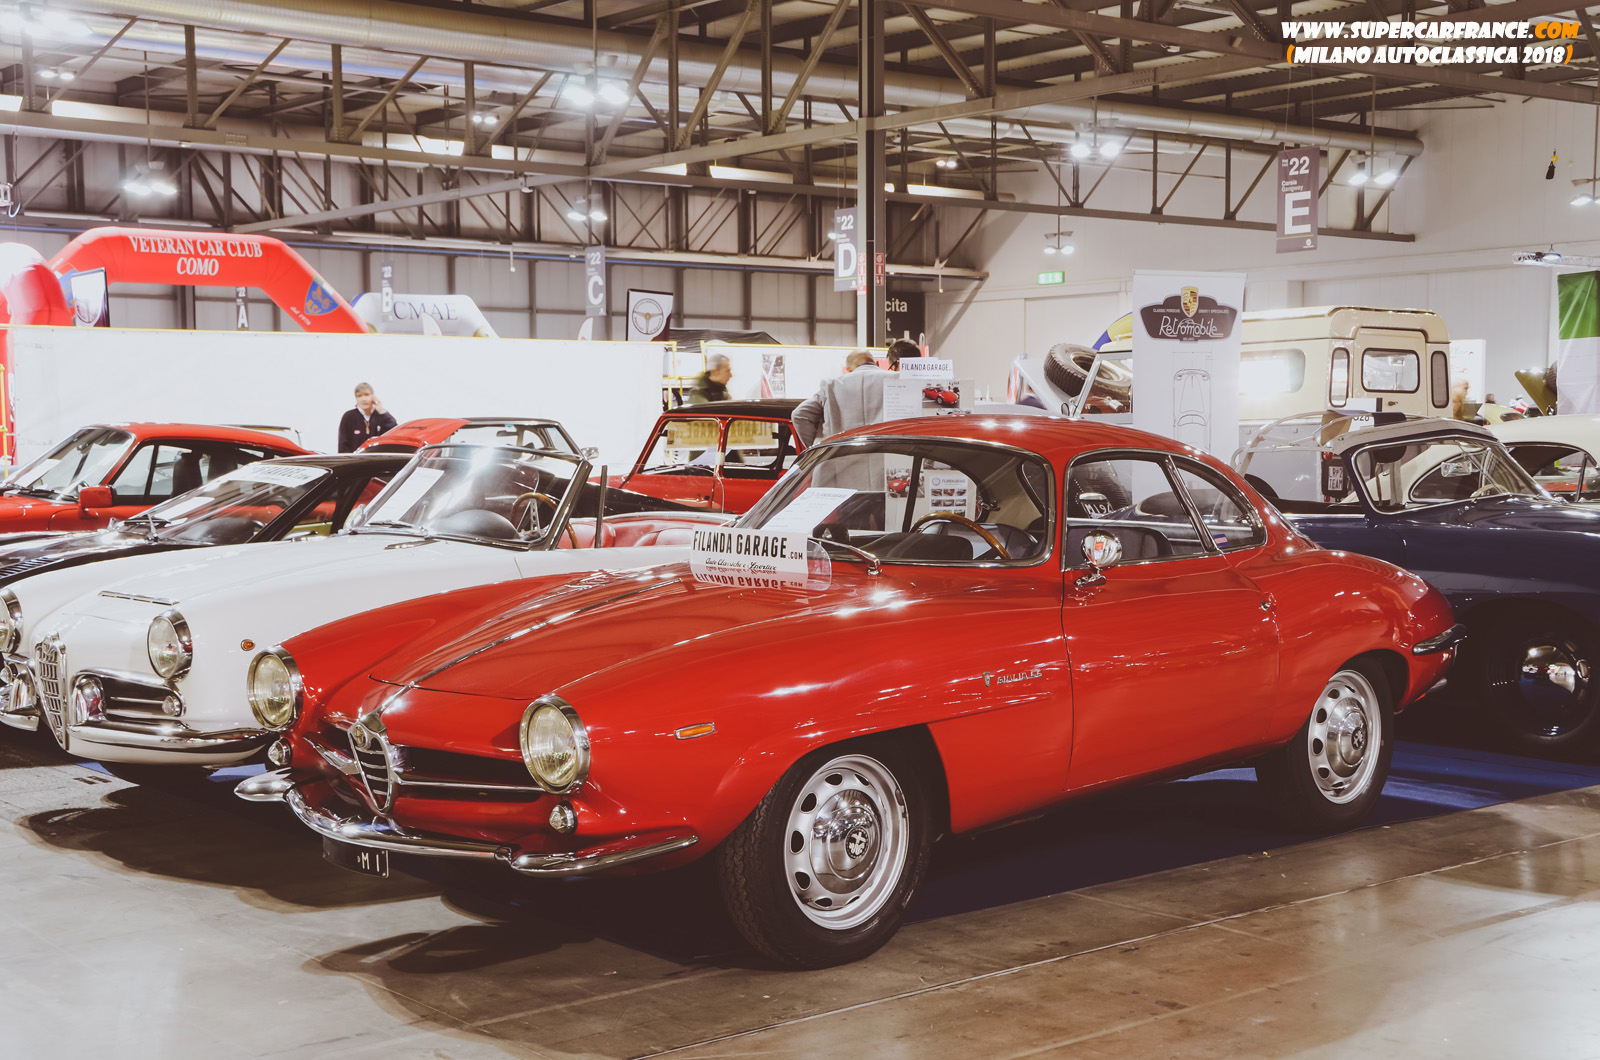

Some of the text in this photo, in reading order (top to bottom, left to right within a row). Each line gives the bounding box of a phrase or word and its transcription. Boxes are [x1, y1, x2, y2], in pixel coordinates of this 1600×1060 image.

[1289, 156, 1310, 176] 22
[1281, 179, 1297, 187] Corsia
[841, 215, 854, 230] 22
[1284, 190, 1311, 235] E
[128, 235, 263, 258] VETERAN CAR CLUB
[176, 257, 219, 276] COMO
[590, 252, 601, 265] 22
[838, 242, 857, 277] D
[382, 287, 393, 312] B
[588, 275, 604, 305] C
[237, 305, 248, 328] A
[393, 301, 458, 320] CMAE
[1158, 315, 1224, 338] Retromobile
[901, 362, 949, 371] FILANDA GARAGE
[693, 530, 732, 554] FILANDA
[736, 533, 788, 559] GARAGE
